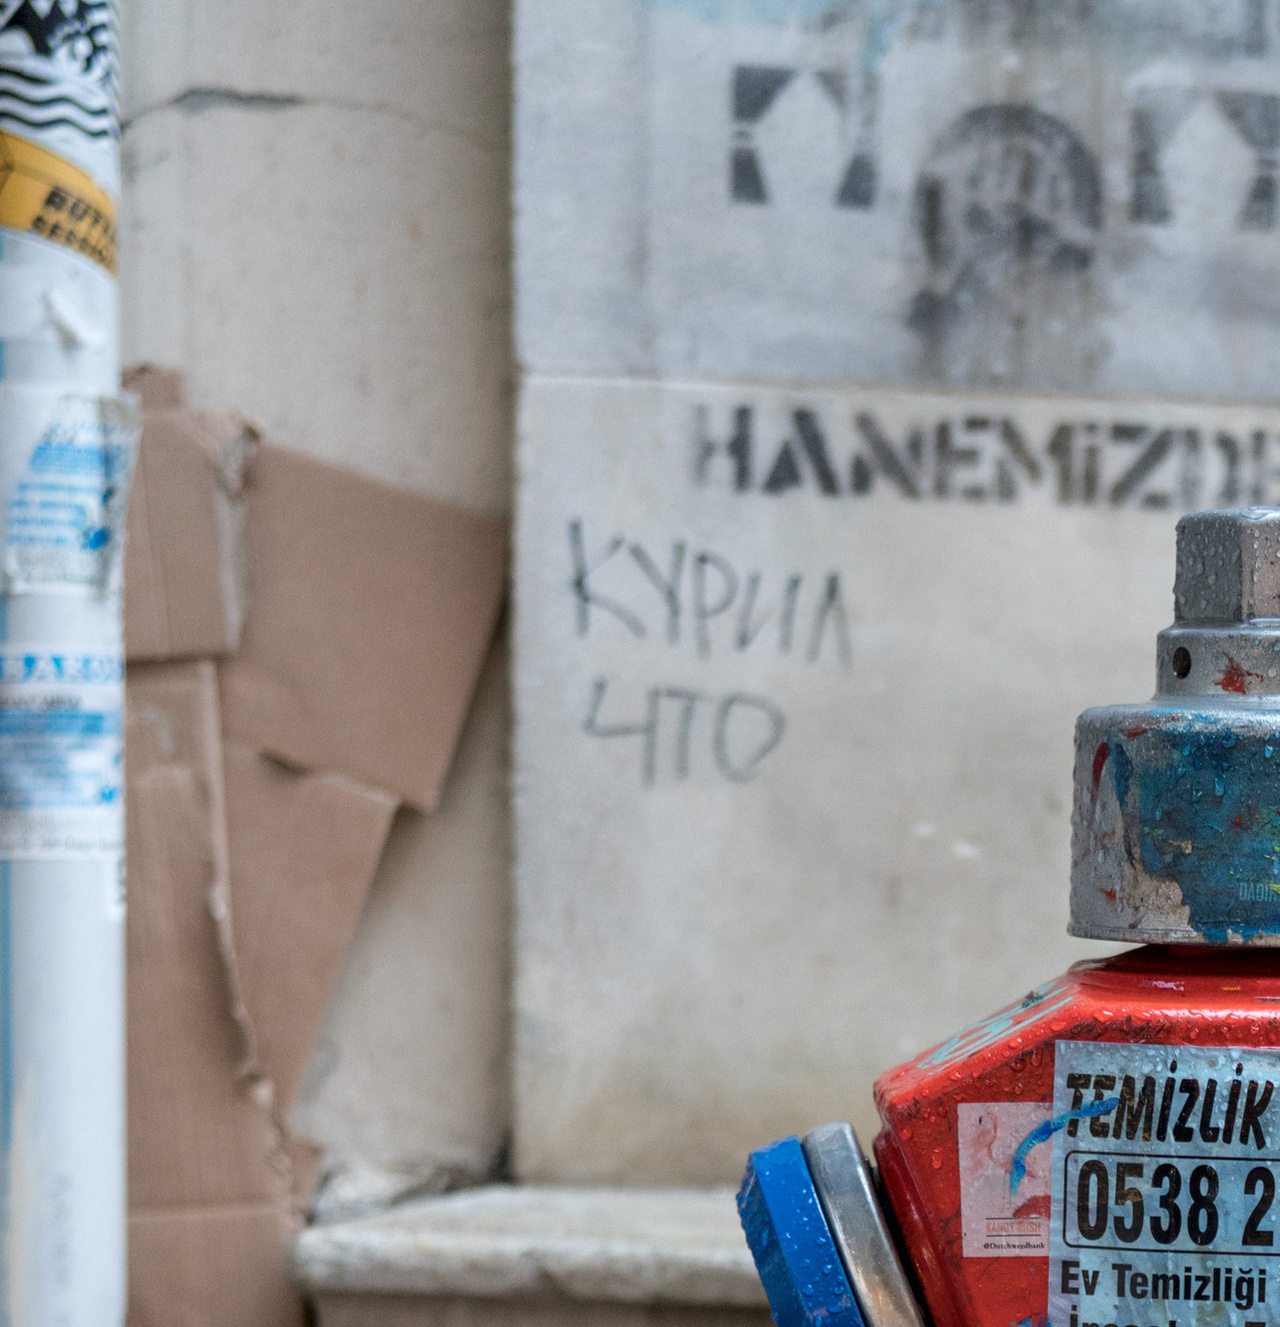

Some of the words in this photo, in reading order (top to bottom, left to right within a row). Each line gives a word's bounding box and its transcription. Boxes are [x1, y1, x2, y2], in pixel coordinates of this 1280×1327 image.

[1066, 1060, 1274, 1150] TEMİZLİK
[1077, 1159, 1219, 1246] 0538
[983, 1241, 1045, 1250] @Dutchweedbank
[1060, 1259, 1099, 1297] Ev
[1111, 1262, 1267, 1311] Temizliği
